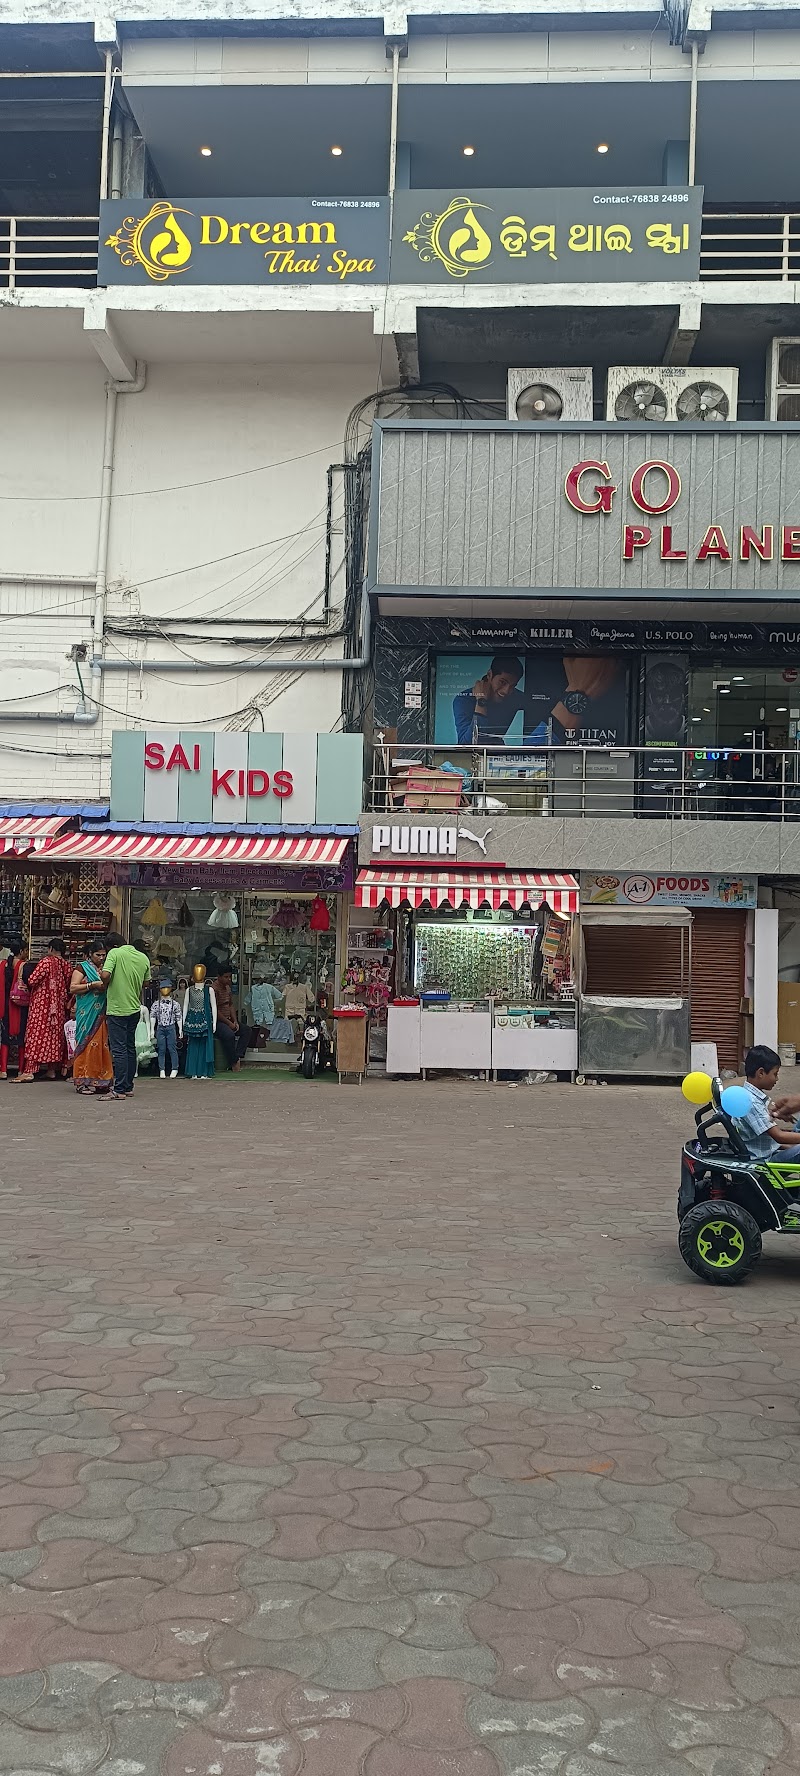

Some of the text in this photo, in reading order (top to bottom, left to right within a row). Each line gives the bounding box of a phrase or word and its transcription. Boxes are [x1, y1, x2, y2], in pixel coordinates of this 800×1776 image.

[311, 200, 380, 209] Contact-76838 24896
[593, 193, 689, 204] Contact-76838 24896
[200, 215, 337, 245] Dream
[568, 223, 633, 253] ଥାଇ
[264, 250, 376, 280] Thai Spa
[565, 459, 682, 514] GO
[623, 524, 800, 561] PLANE
[530, 628, 573, 638] KILLER
[645, 631, 693, 640] U.S. POLO
[580, 728, 617, 739] TITAN
[144, 742, 201, 771] SAI
[212, 769, 294, 798] KIDS
[372, 825, 457, 855] PUMA
[173, 875, 193, 885] Baby
[199, 866, 217, 876] Baby
[627, 877, 710, 899] A-1 FOODS
